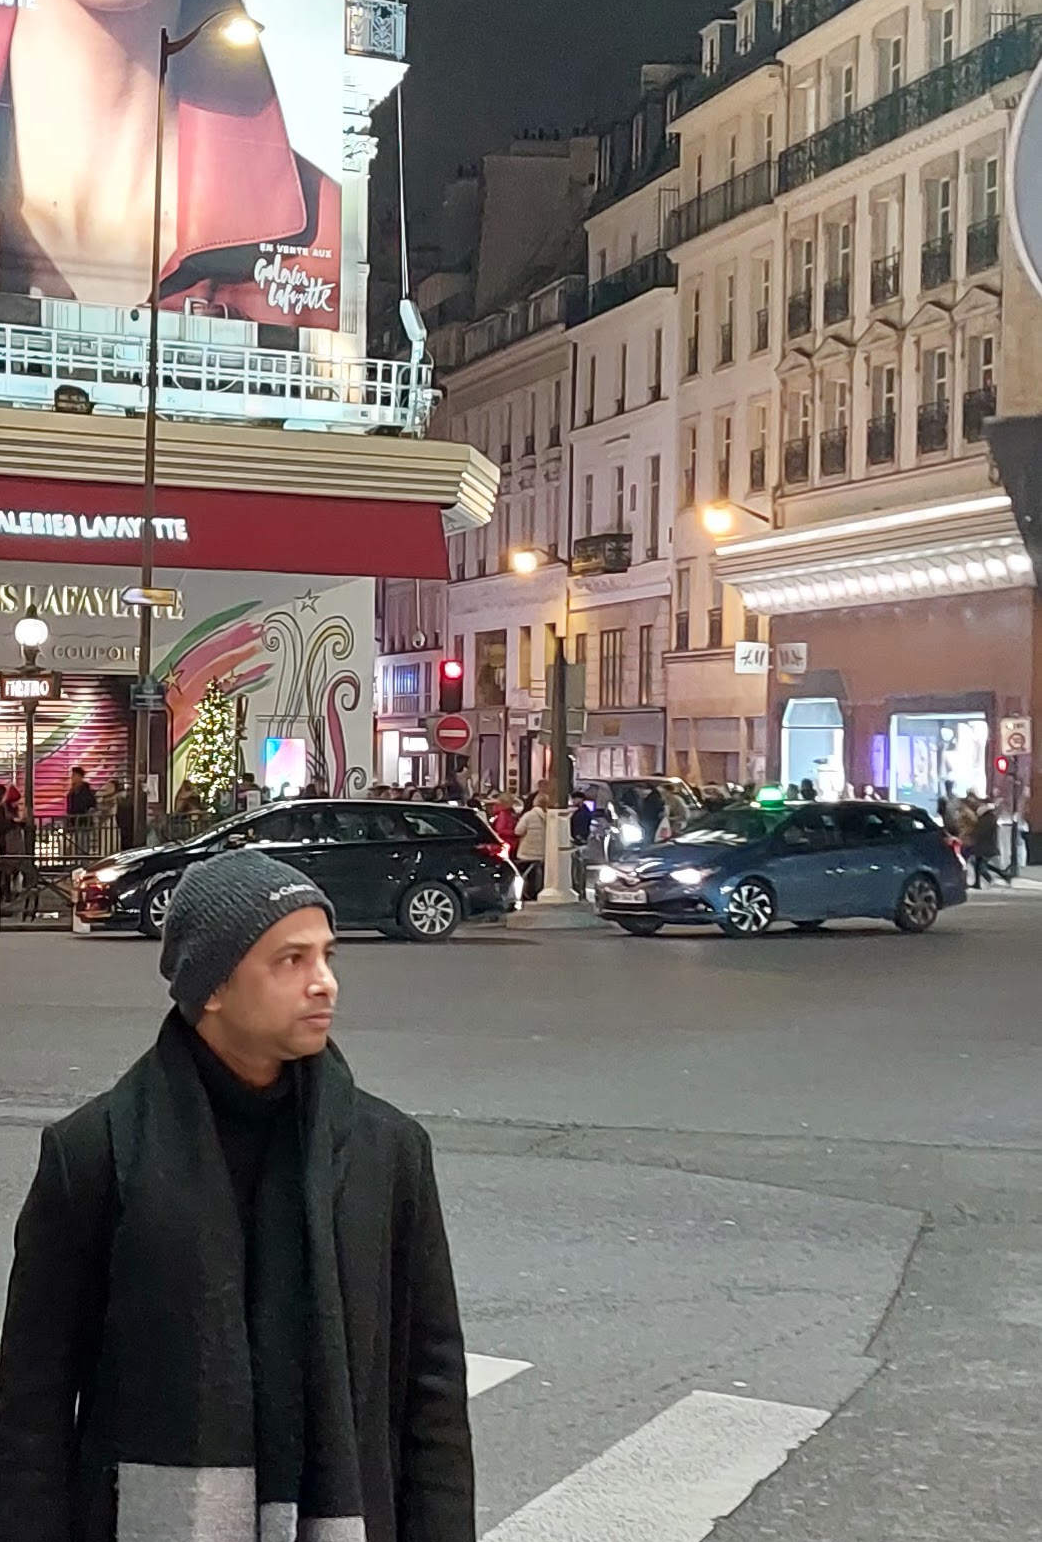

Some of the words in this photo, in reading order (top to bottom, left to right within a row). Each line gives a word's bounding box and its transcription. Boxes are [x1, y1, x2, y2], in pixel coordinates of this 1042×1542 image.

[254, 253, 309, 290] Galeries
[268, 277, 336, 316] Lafayette
[79, 513, 188, 541] LAFAYTTE
